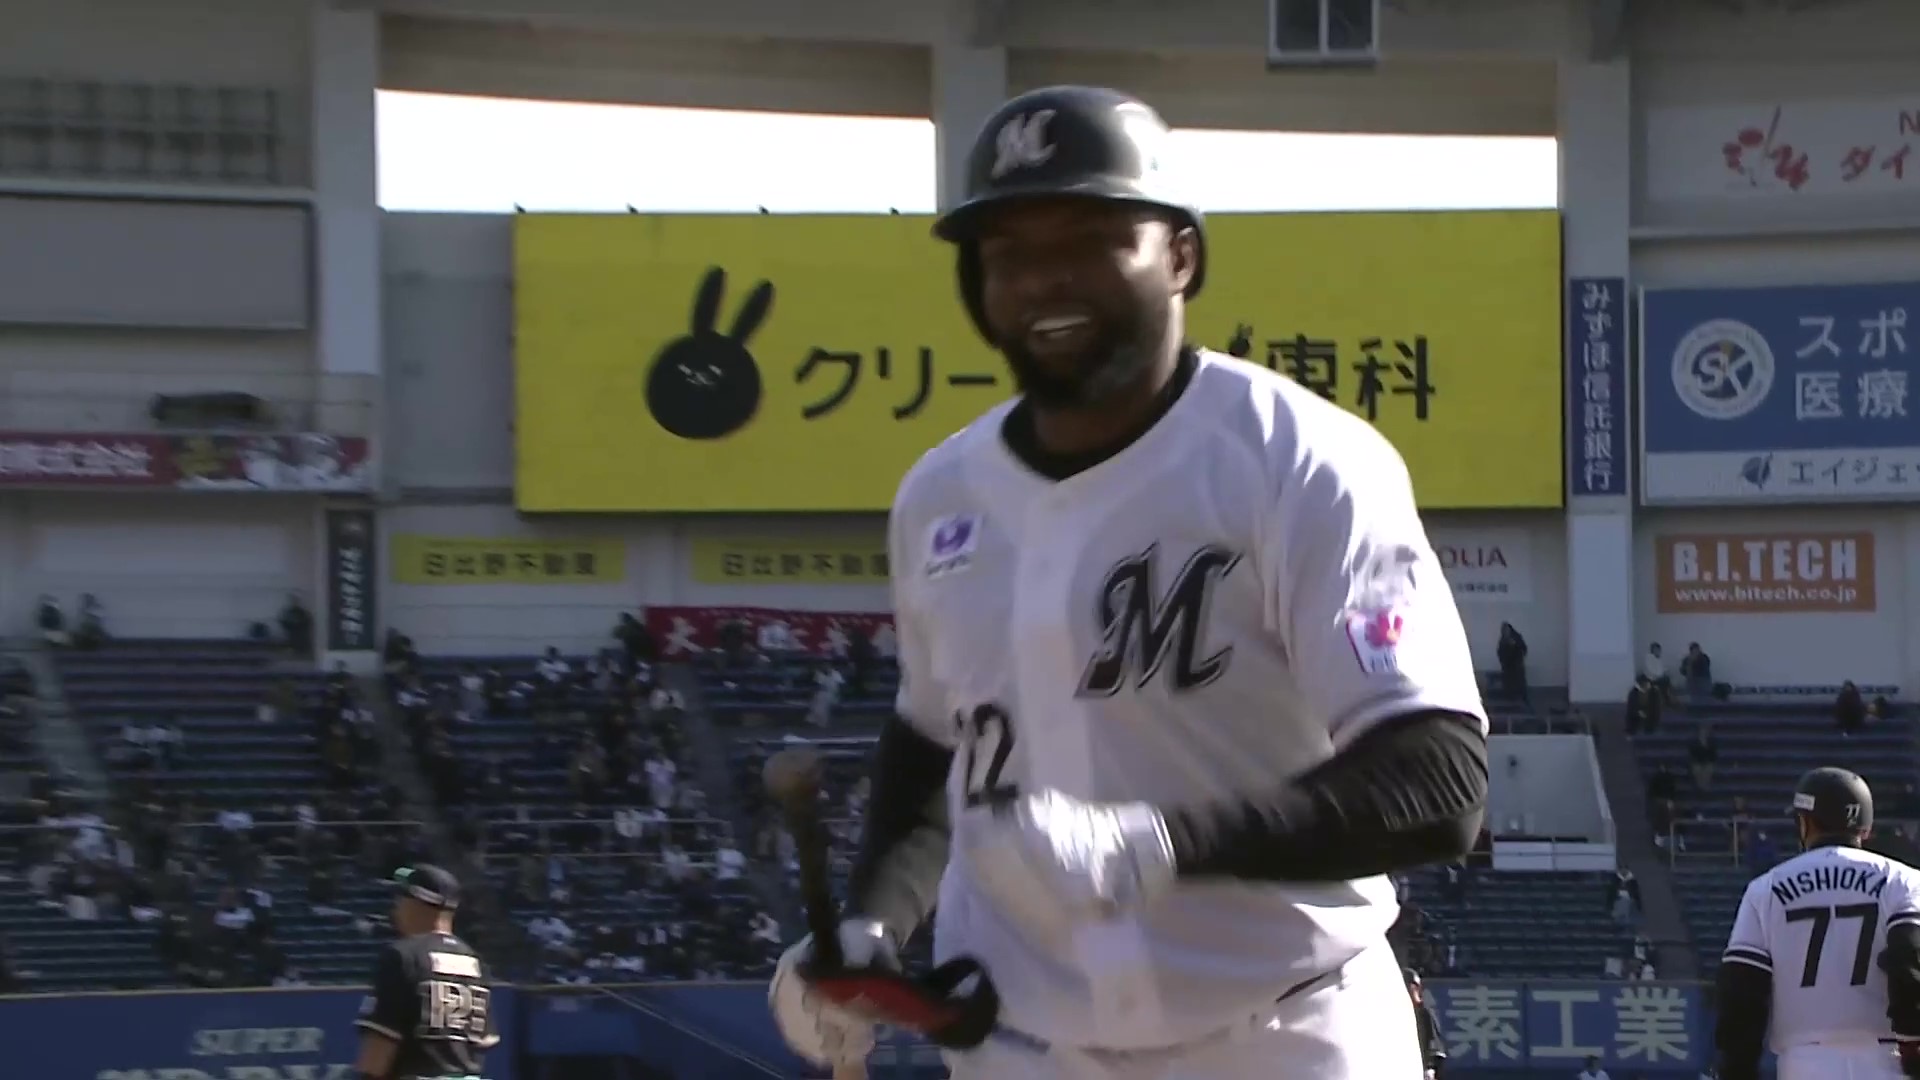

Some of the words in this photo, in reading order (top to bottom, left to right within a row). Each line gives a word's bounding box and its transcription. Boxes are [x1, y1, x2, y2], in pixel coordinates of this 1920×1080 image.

[990, 109, 1057, 178] M
[1840, 143, 1911, 181] ダイ
[1795, 305, 1909, 358] スポ
[1795, 369, 1909, 420] 医療
[1789, 456, 1920, 487] エイジェ
[1673, 539, 1857, 582] B.I.TECH
[1674, 584, 1858, 604] www.bitech.co.jp
[1074, 540, 1244, 700] M
[1771, 865, 1888, 906] NISHIOKA
[1785, 902, 1879, 988] 77
